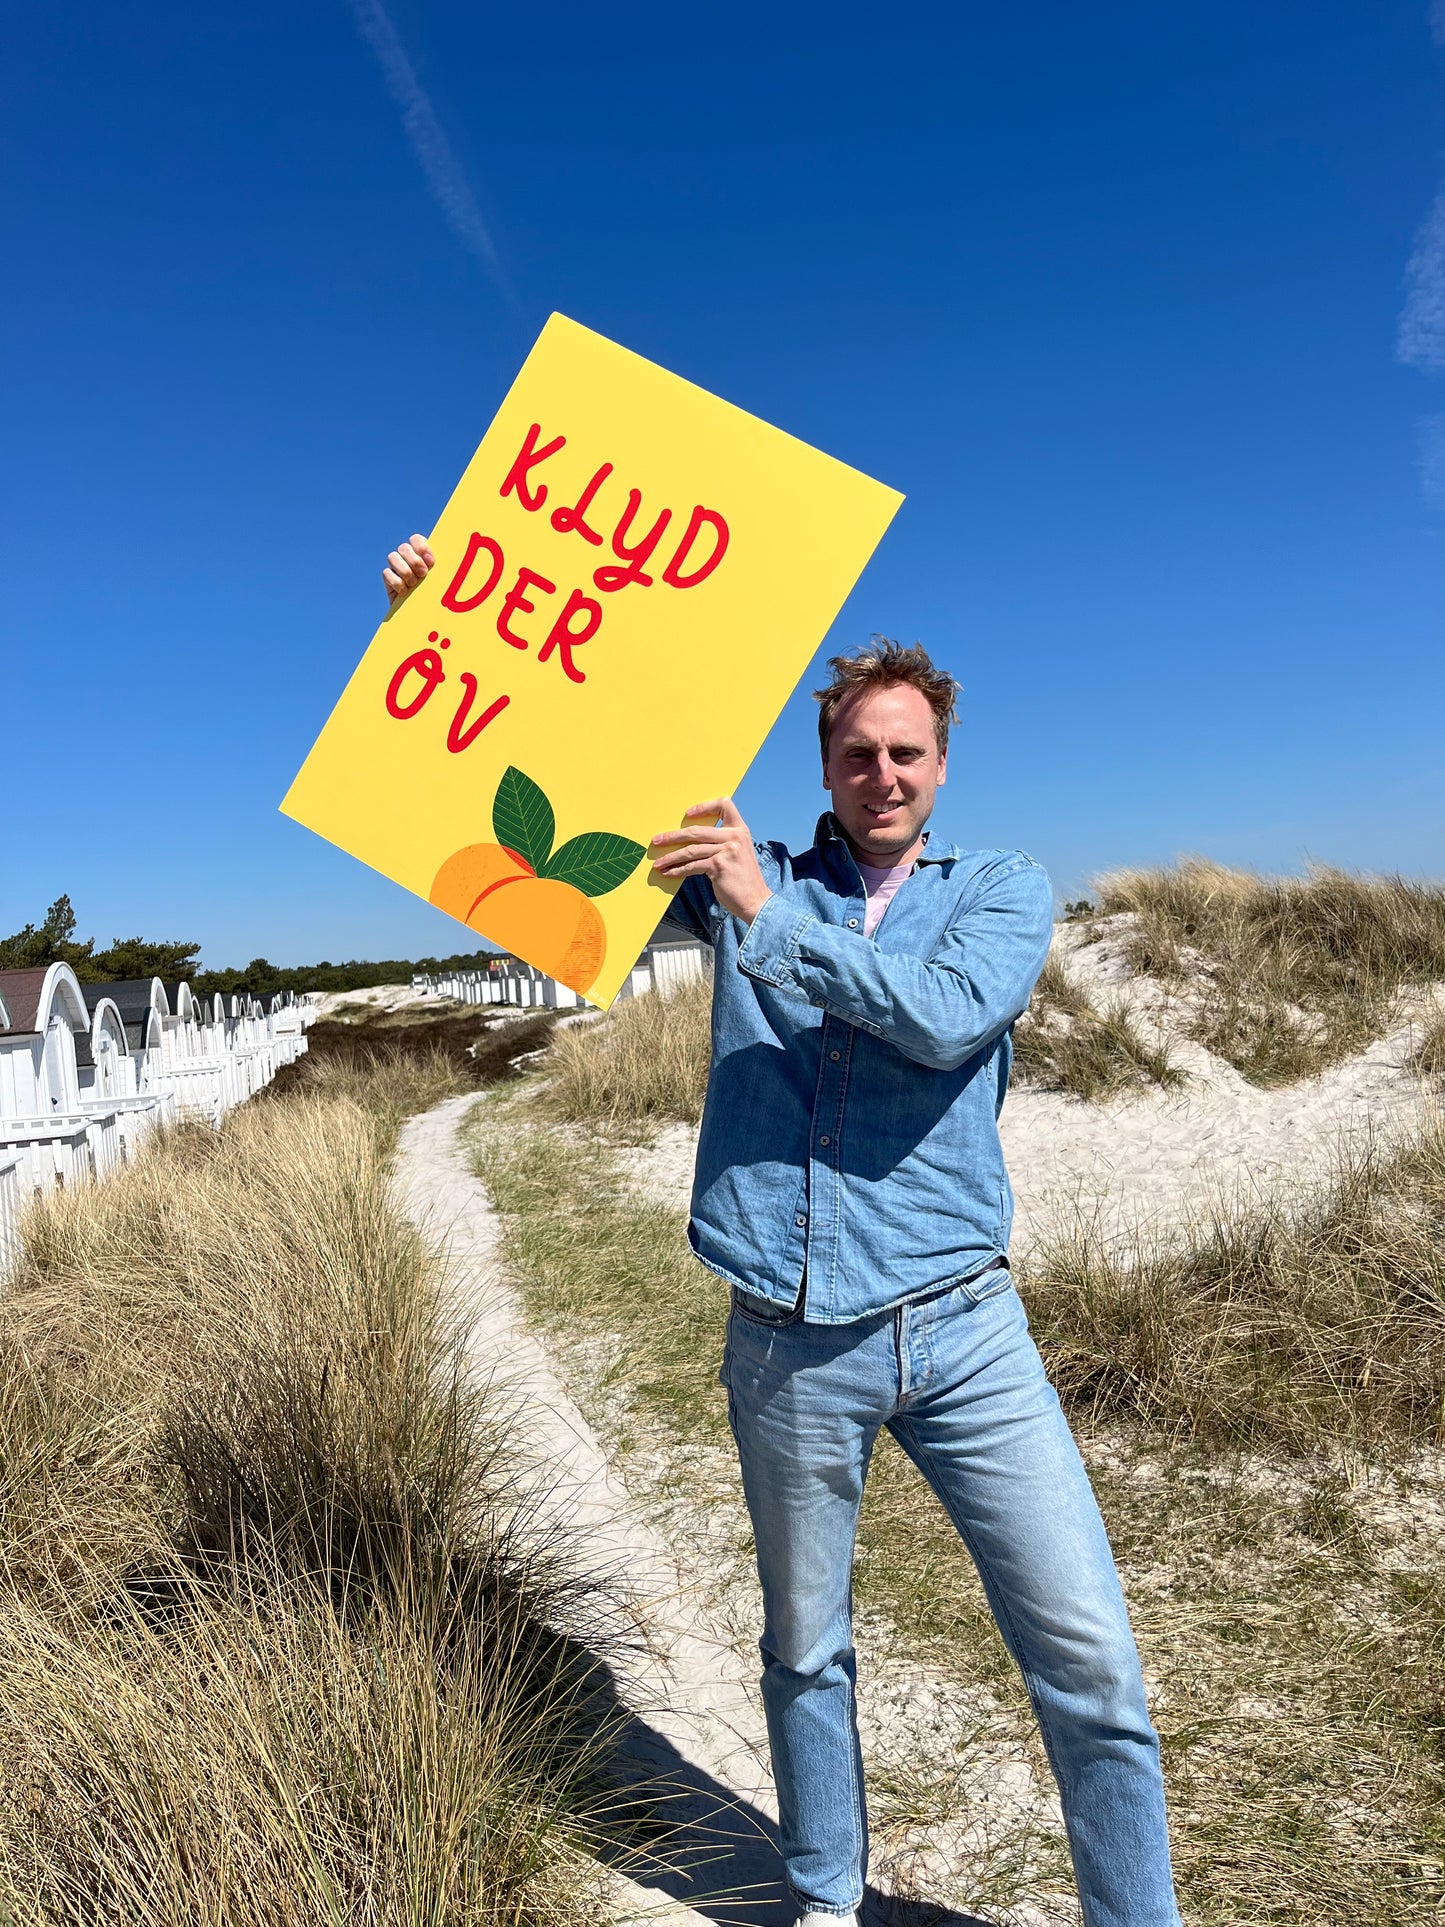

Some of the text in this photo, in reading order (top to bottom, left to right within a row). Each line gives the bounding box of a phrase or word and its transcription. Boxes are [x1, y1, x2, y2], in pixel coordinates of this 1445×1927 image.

[500, 424, 730, 593] KLYD
[441, 532, 603, 684] DER
[386, 631, 511, 754] ÖV
